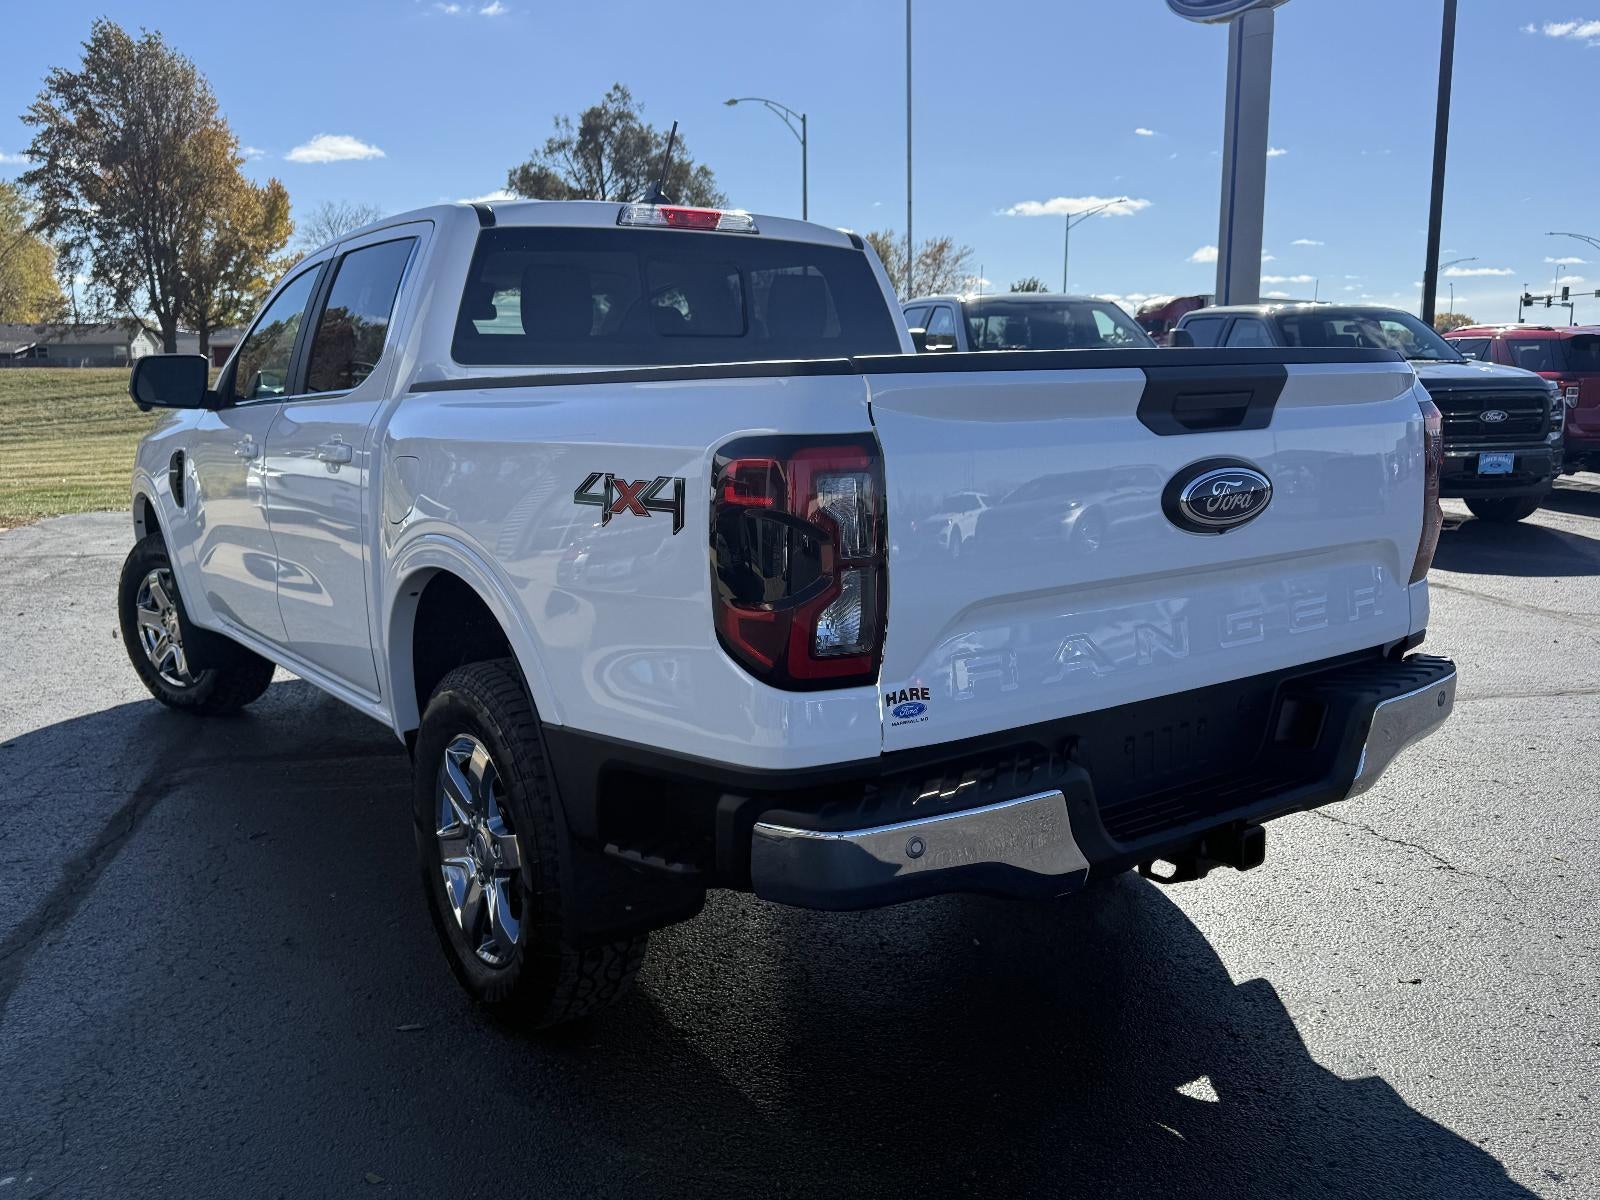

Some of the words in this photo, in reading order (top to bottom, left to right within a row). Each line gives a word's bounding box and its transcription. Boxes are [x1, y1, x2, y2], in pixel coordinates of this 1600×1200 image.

[1485, 411, 1502, 421] Ford
[1206, 480, 1256, 513] Ford
[947, 580, 1385, 700] RANGER
[886, 687, 931, 707] HARE
[899, 705, 920, 716] Ford
